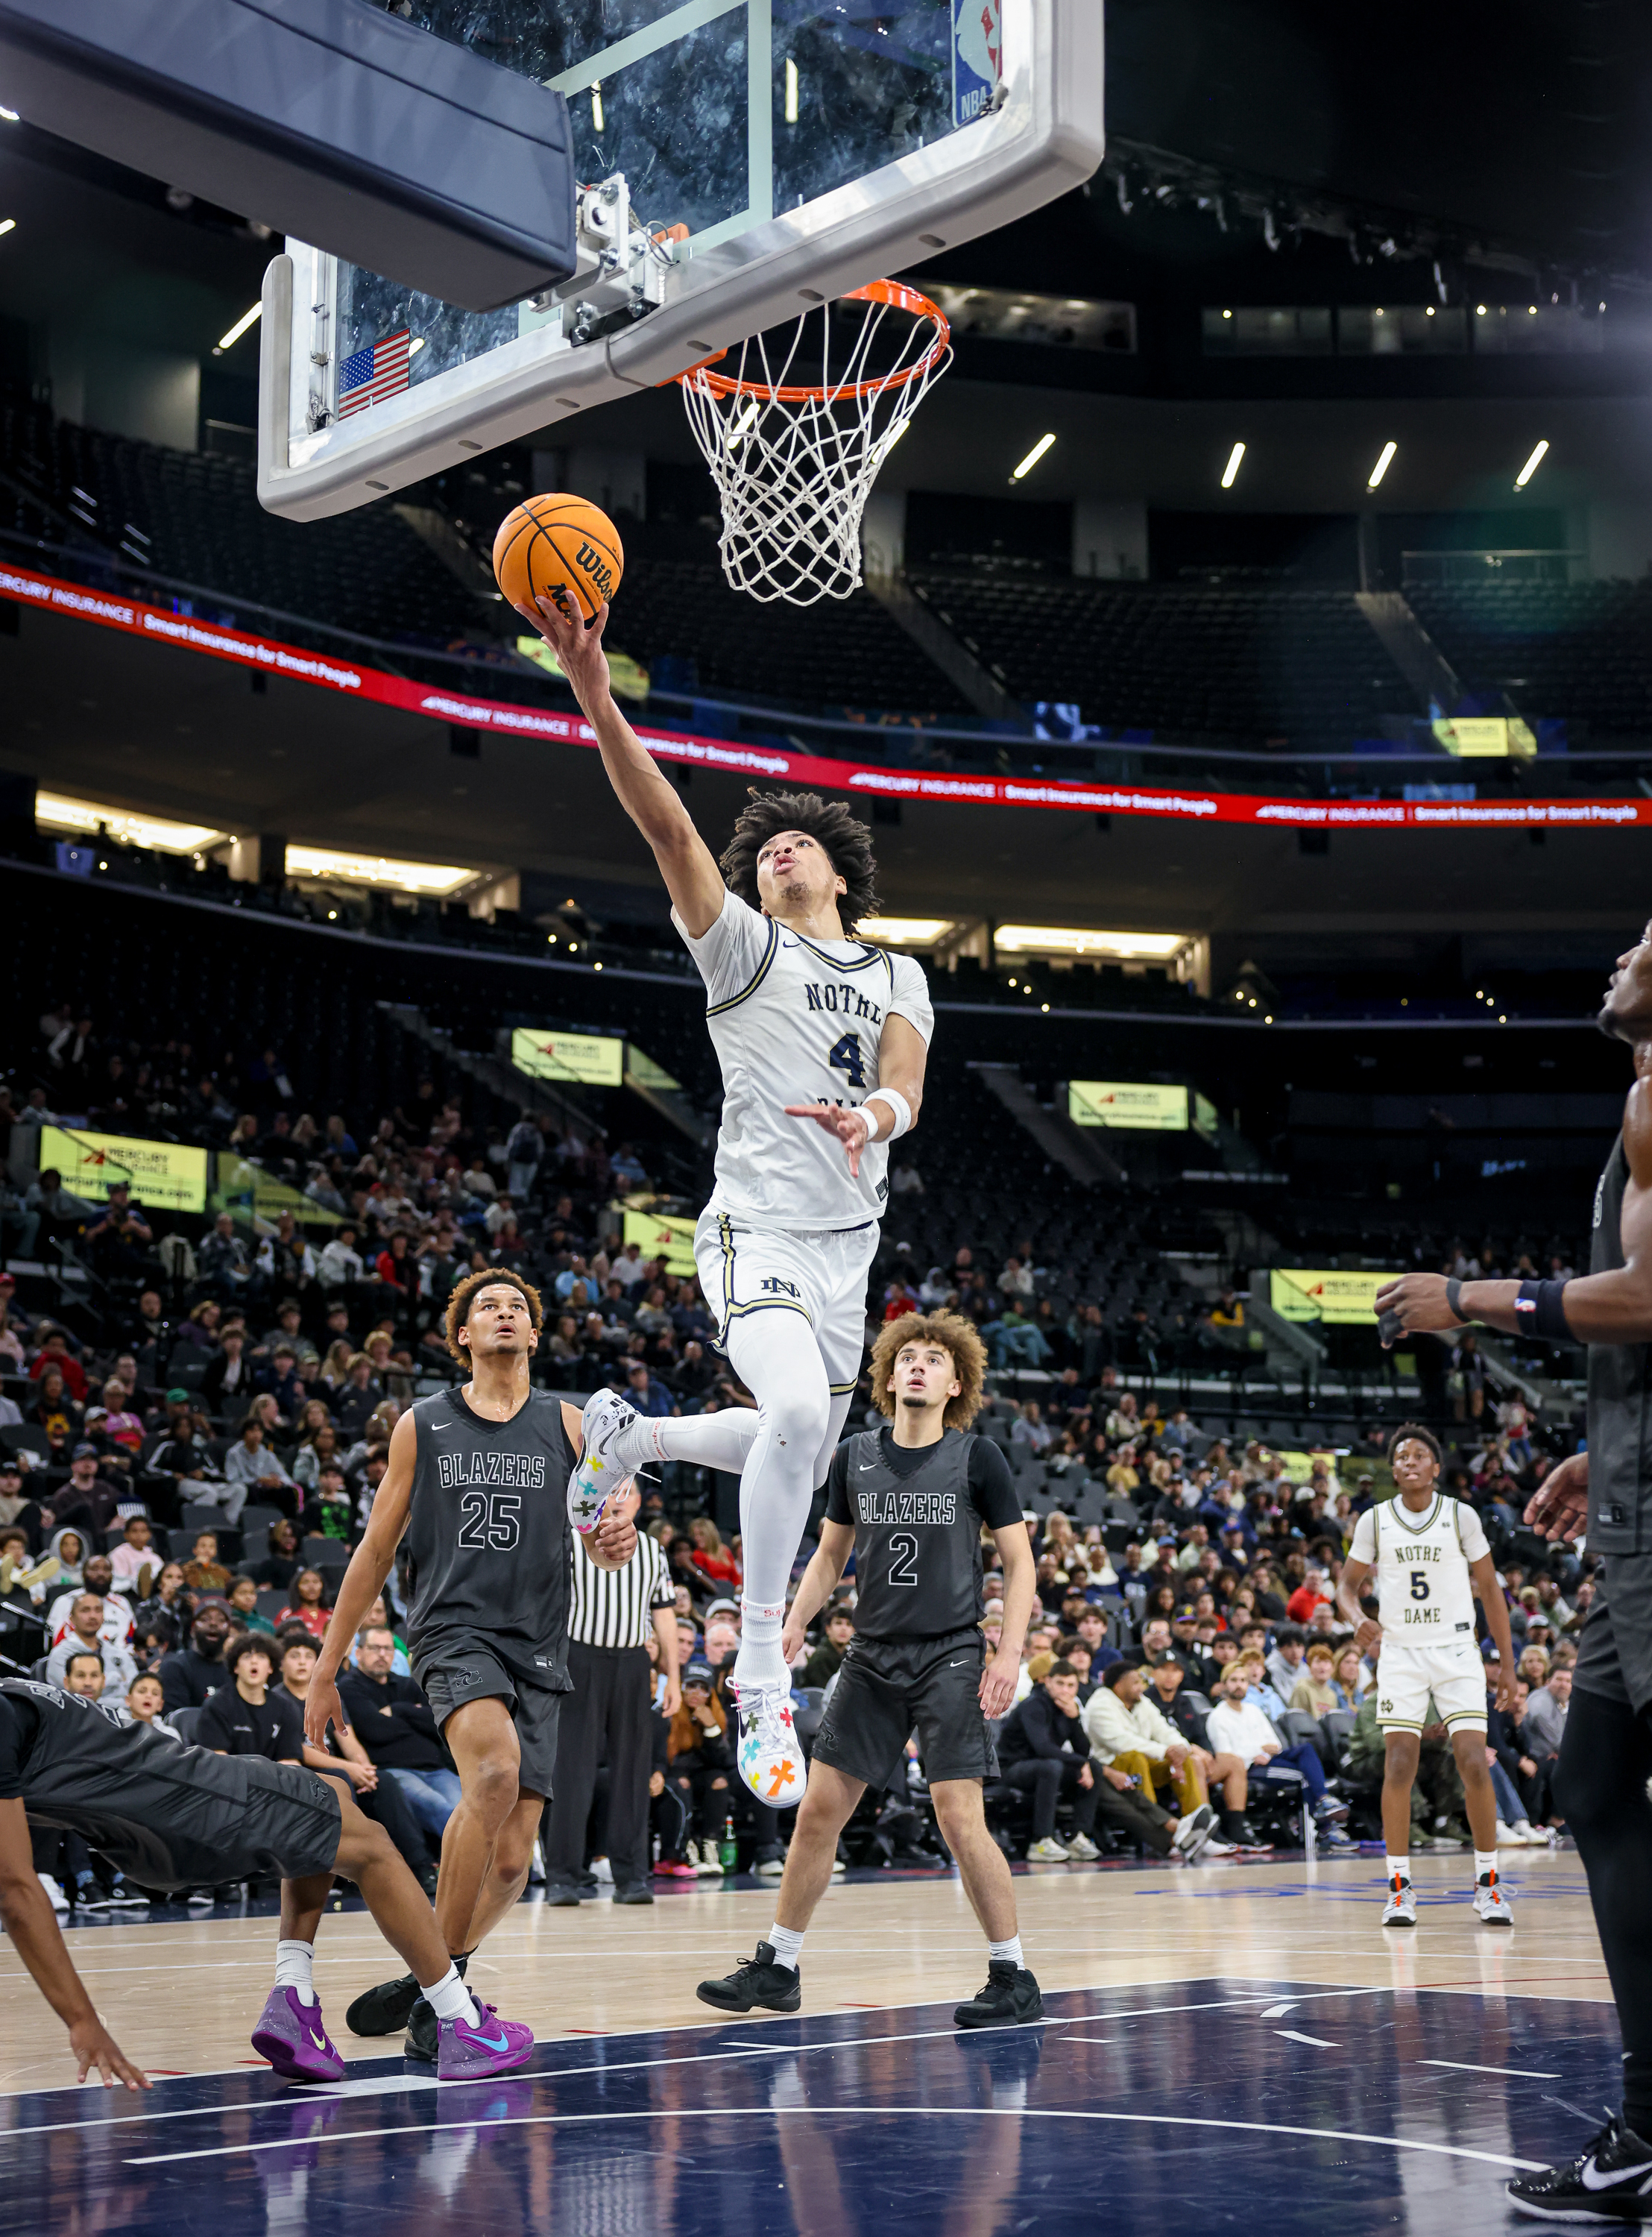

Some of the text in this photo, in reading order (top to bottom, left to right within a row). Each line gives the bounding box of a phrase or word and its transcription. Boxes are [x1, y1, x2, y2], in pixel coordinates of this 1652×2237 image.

[576, 540, 612, 602] Wilso
[52, 588, 134, 624] INSURANCE
[438, 696, 493, 723] MERCURY
[492, 710, 570, 736] INSURANCE
[921, 779, 996, 798] INSURANCE
[1328, 808, 1404, 821] INSURANCE
[828, 1031, 867, 1088] 4
[438, 1453, 545, 1488] BLAZERS
[458, 1492, 521, 1551] 25
[858, 1493, 956, 1524] BLAZERS
[889, 1532, 918, 1586] 2
[1394, 1545, 1441, 1564] NOTRE
[1410, 1570, 1431, 1601] 5
[1404, 1608, 1441, 1623] DAME
